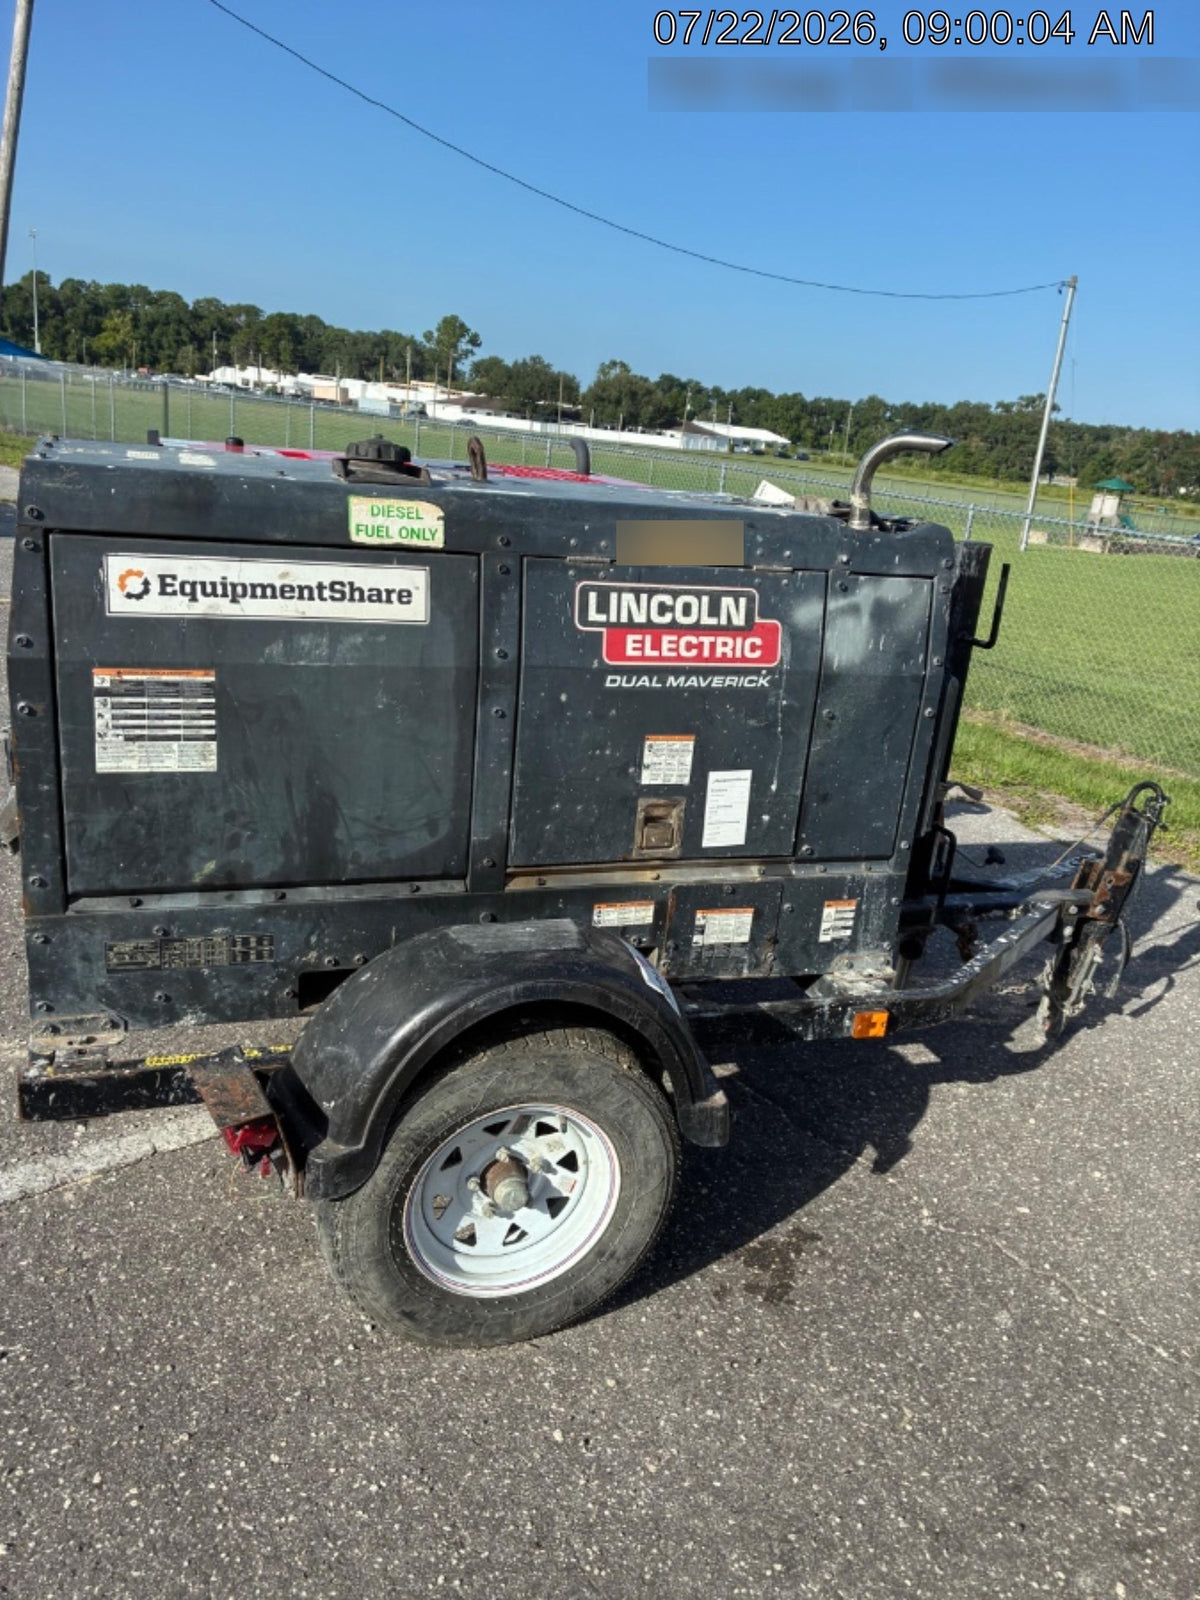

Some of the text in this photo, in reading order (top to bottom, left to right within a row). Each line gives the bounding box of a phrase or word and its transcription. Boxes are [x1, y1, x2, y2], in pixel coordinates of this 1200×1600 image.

[370, 504, 424, 520] DIESEL
[355, 523, 438, 541] FUEL ONLY
[157, 573, 413, 606] EquipmentShare
[587, 591, 748, 627] LINCOLN
[625, 634, 763, 659] ELECTRIC
[605, 675, 771, 689] DUAL MAVERICK
